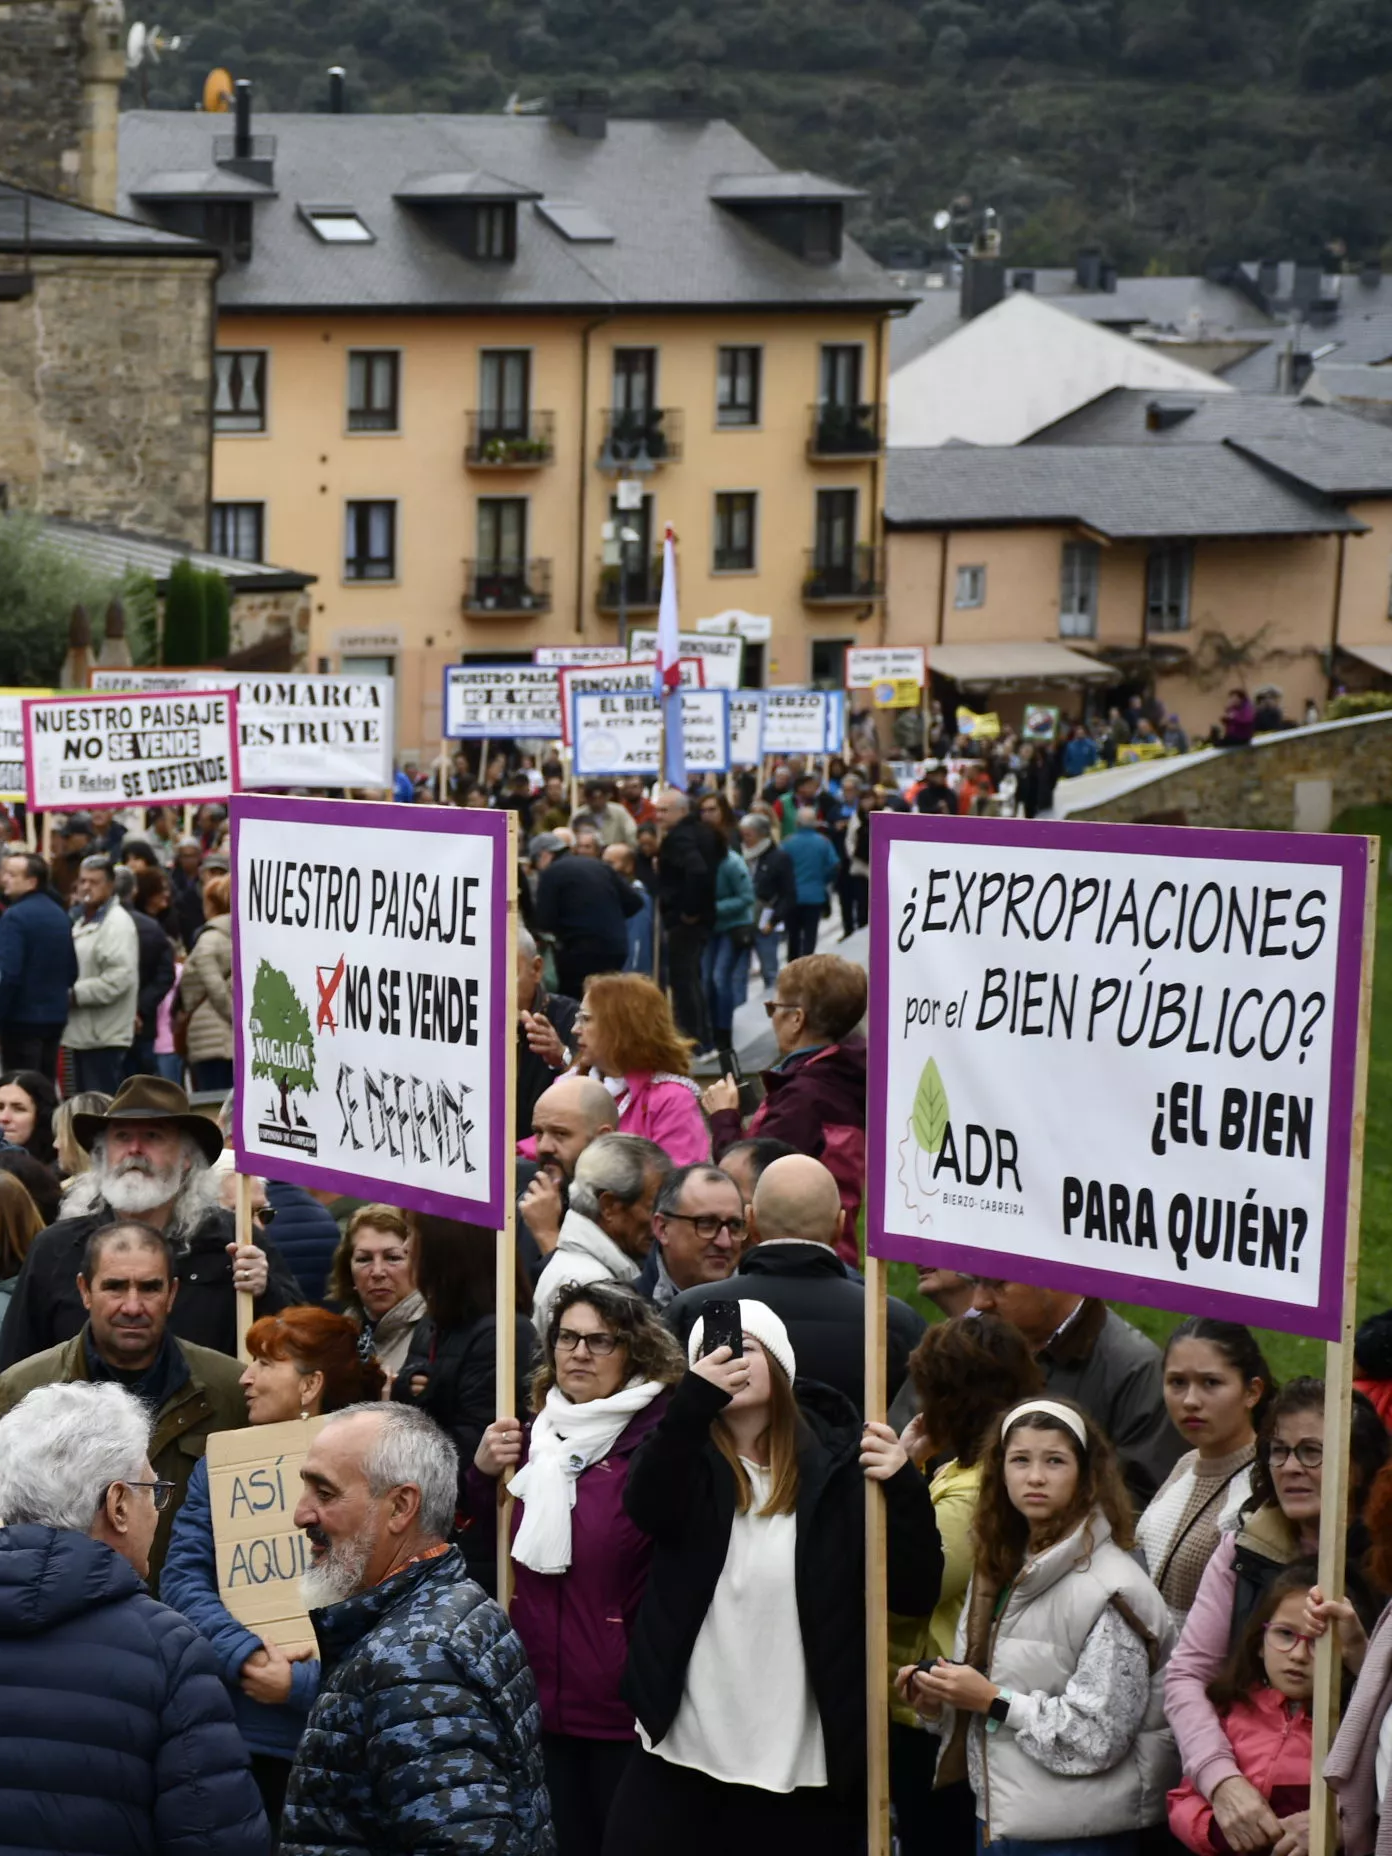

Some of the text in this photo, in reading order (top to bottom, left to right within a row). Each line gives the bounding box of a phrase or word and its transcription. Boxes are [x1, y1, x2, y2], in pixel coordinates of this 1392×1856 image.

[235, 682, 381, 708] COMARCA
[451, 673, 514, 684] NUESTRO
[35, 707, 133, 733] NUESTRO
[141, 702, 225, 727] PAISAJE
[64, 731, 200, 760] NO SE VENDE
[122, 772, 143, 797] SE
[148, 756, 228, 793] DEFIENDE
[249, 858, 480, 946] NUESTRO PAISAJE
[897, 868, 1327, 960] ¿EXPROPIACIONES
[345, 964, 478, 1046] NO SE VENDE
[904, 958, 1326, 1065] por el BIEN PÚBLICO?
[255, 1033, 310, 1071] NOGALÓN
[364, 1066, 477, 1174] DEFIENDE
[932, 1120, 1023, 1194] ADR
[1151, 1081, 1314, 1160] ¿EL BIEN
[1062, 1176, 1309, 1273] PARA QUIÉN?
[230, 1454, 286, 1519] ASÍ
